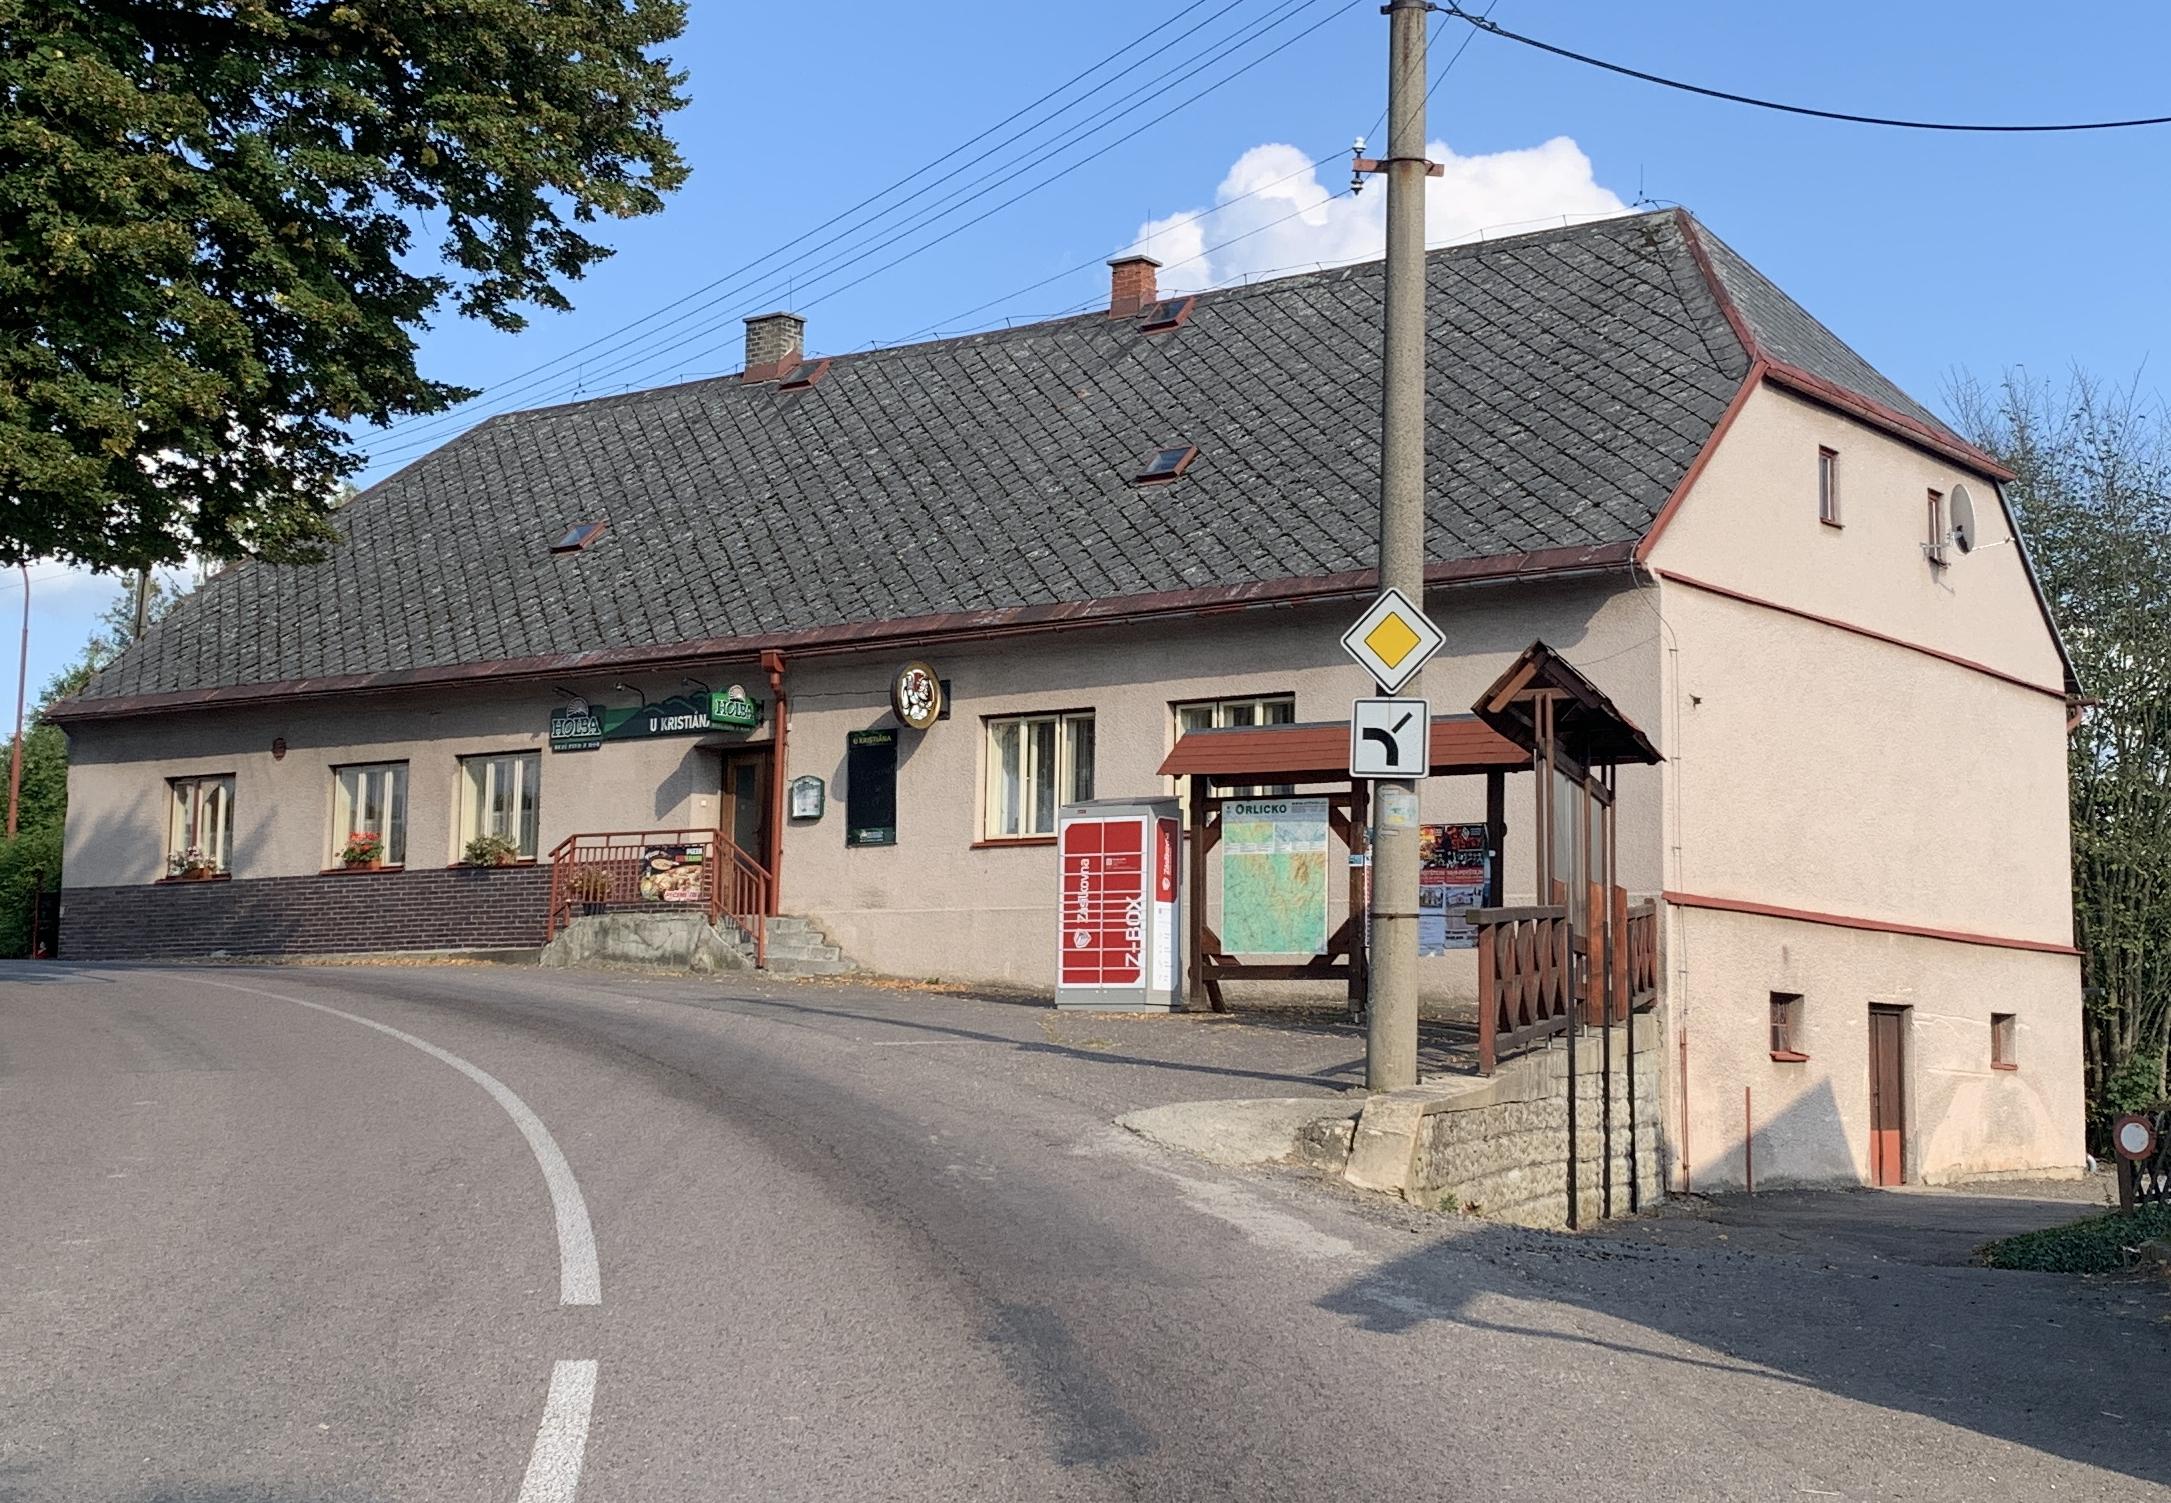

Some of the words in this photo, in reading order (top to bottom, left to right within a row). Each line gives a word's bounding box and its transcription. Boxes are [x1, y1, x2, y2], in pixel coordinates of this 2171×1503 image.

[551, 716, 602, 738] HOLBA
[649, 718, 657, 732] U
[1235, 804, 1287, 815] ORLICKO
[1125, 896, 1141, 967] Z-BOX
